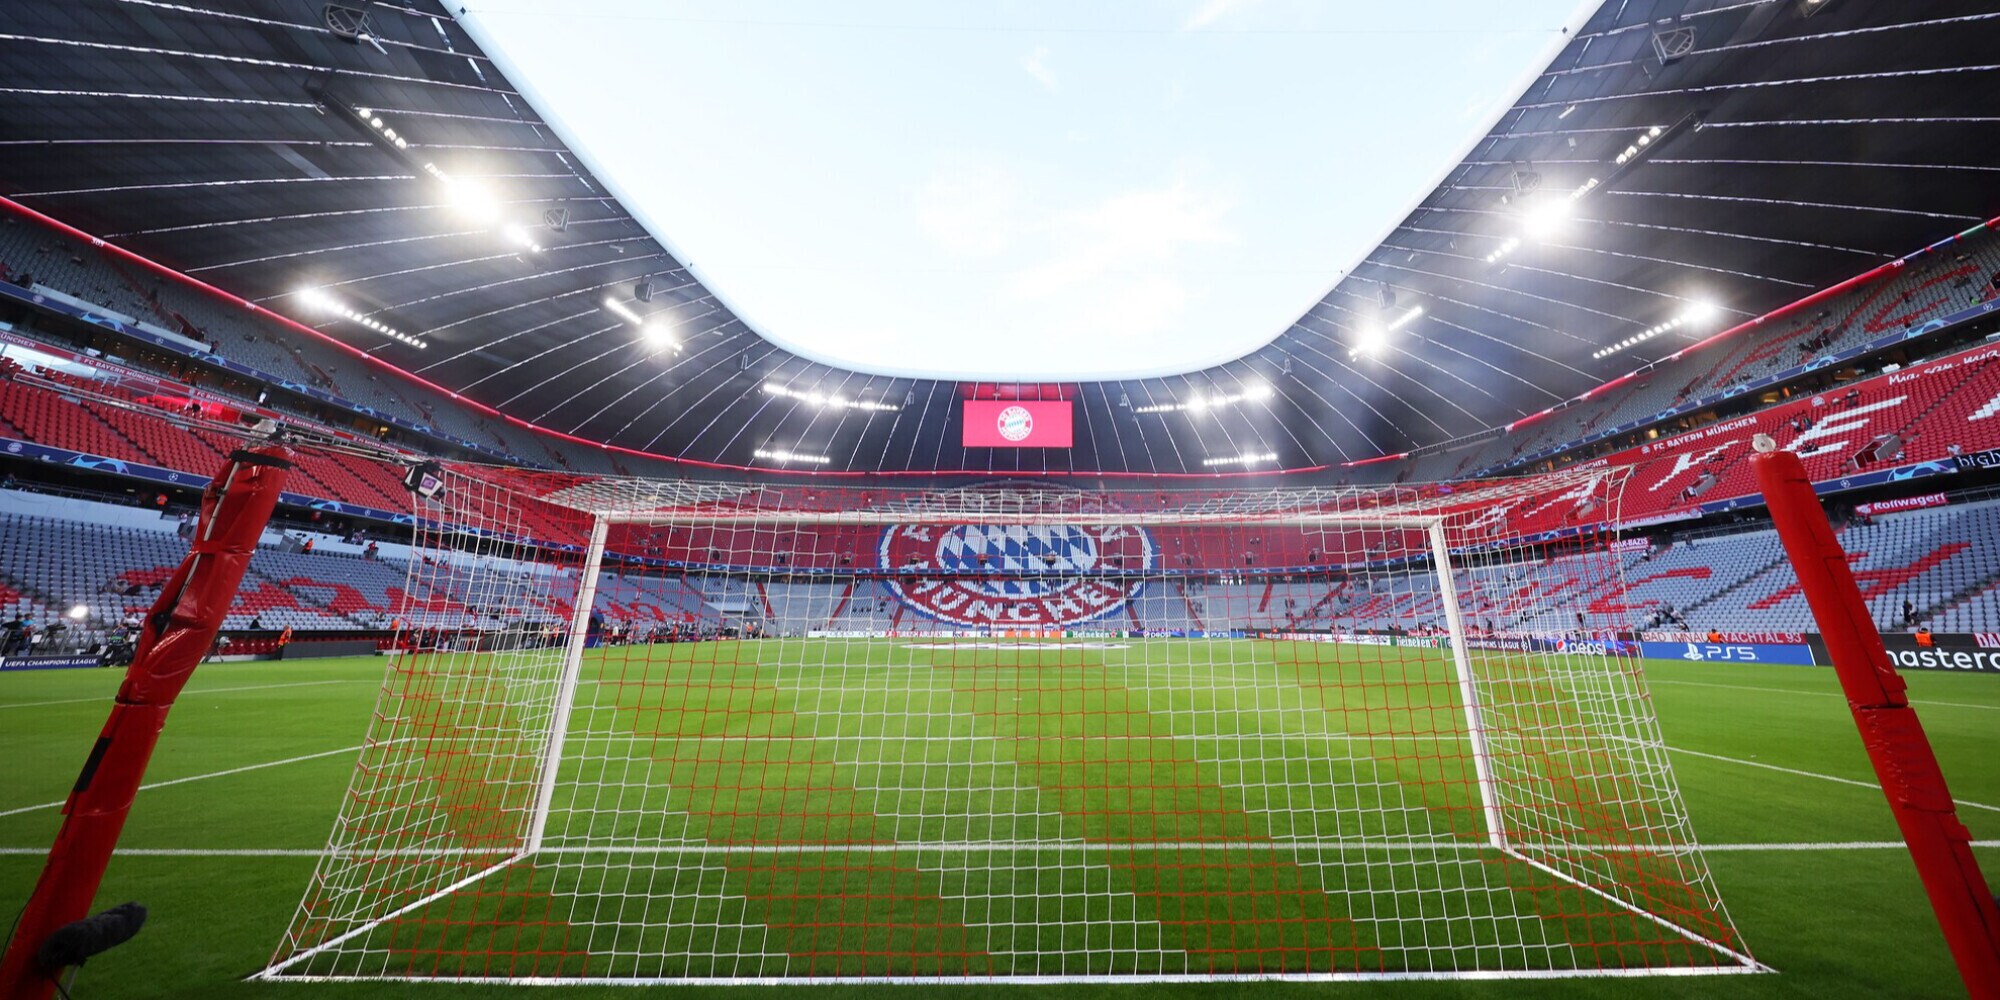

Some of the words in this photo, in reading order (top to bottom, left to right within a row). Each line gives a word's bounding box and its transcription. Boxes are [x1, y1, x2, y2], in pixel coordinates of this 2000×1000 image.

[84, 358, 95, 367] FC
[95, 361, 126, 375] BAYERN
[126, 369, 161, 385] MÜNCHEN
[1653, 441, 1665, 451] FC
[1667, 431, 1704, 448] BAYERN
[1706, 416, 1758, 438] MÜNCHEN
[1642, 632, 1667, 642] BAD
[1786, 633, 1802, 643] 93
[1705, 645, 1757, 661] PS5
[27, 659, 70, 667] CHAMPIONS
